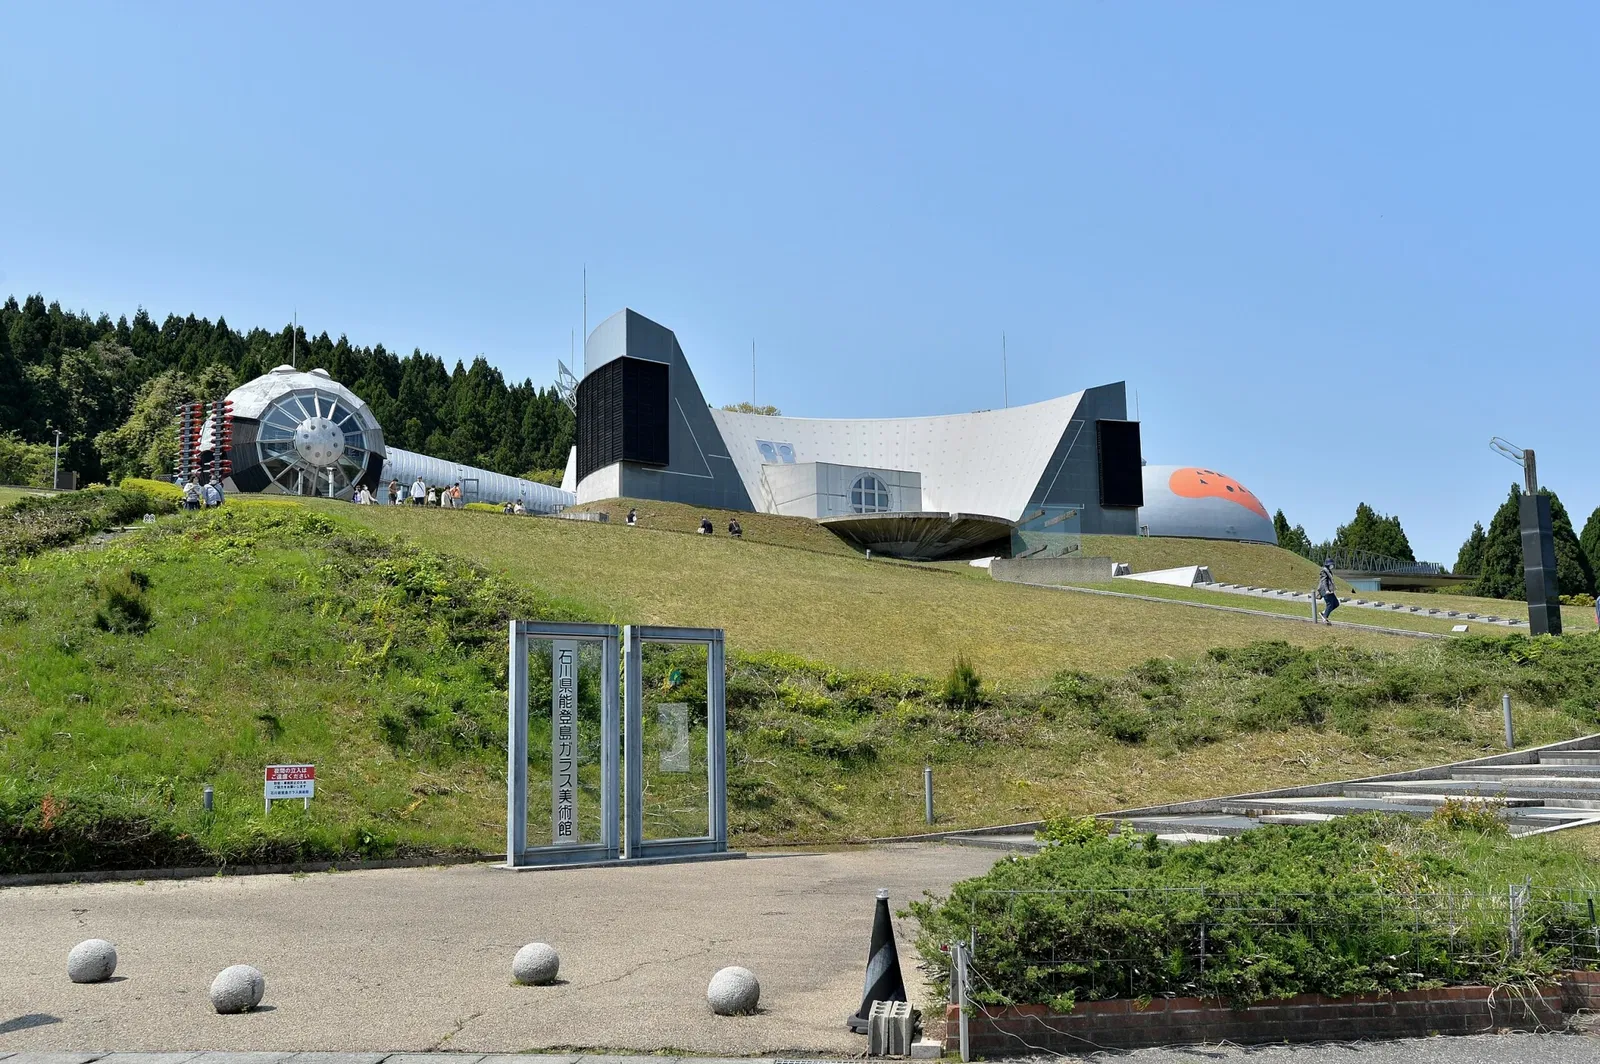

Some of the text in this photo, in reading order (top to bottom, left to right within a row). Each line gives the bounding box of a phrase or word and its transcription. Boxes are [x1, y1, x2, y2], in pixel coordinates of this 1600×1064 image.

[558, 649, 573, 836] 石川県能登島ガラス美術館
